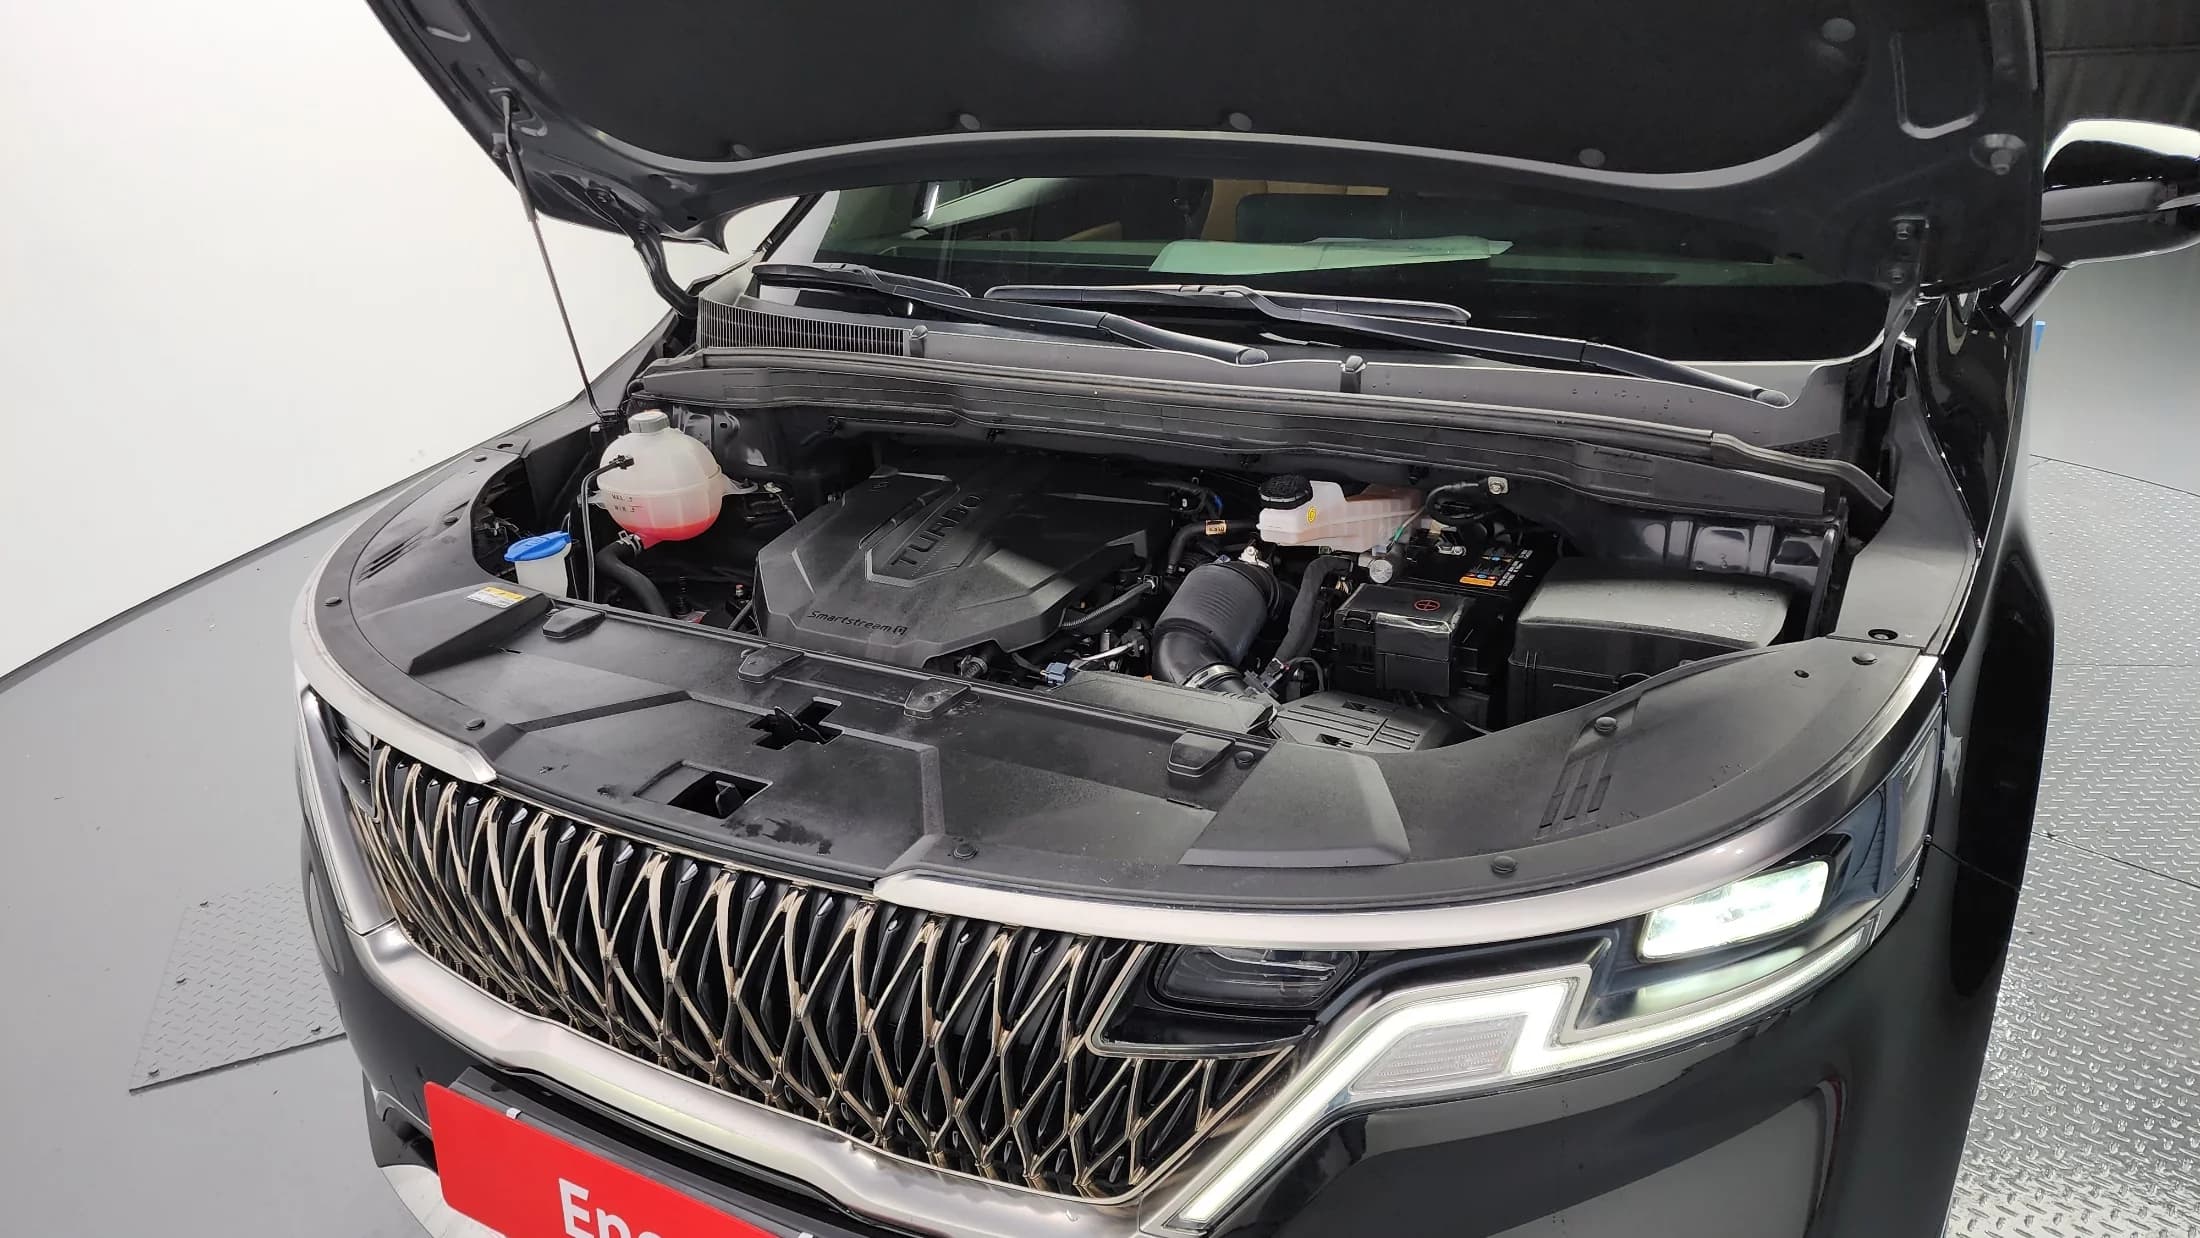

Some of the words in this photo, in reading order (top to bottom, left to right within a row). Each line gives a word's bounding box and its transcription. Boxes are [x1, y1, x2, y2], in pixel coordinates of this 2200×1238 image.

[891, 494, 984, 566] TURBO
[807, 610, 893, 633] Smartstream
[558, 1177, 661, 1238] En
